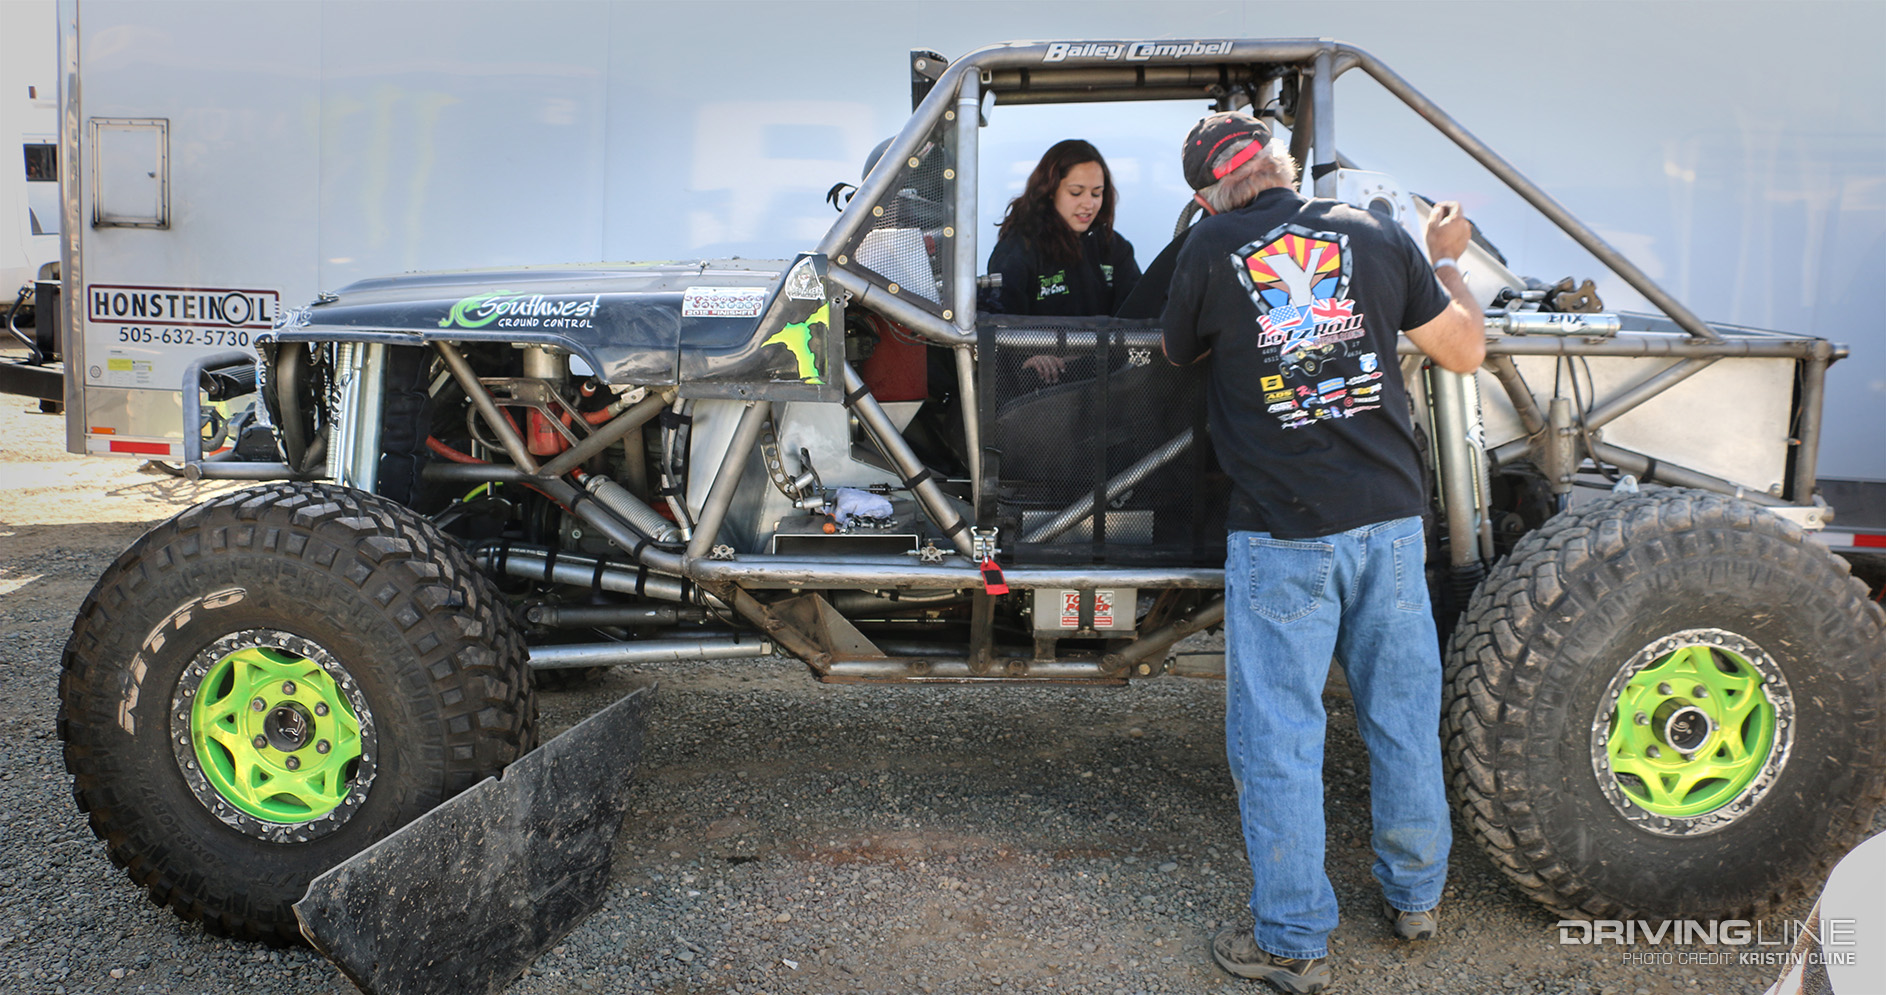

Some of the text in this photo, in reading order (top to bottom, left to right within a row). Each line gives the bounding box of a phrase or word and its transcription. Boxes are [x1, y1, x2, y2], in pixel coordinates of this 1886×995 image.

[1042, 41, 1234, 63] Bailey Campbell
[477, 294, 601, 318] Southwest
[498, 317, 593, 329] GROUND CONTROL
[119, 326, 249, 347] 505-632-5730
[1065, 594, 1104, 603] TOL
